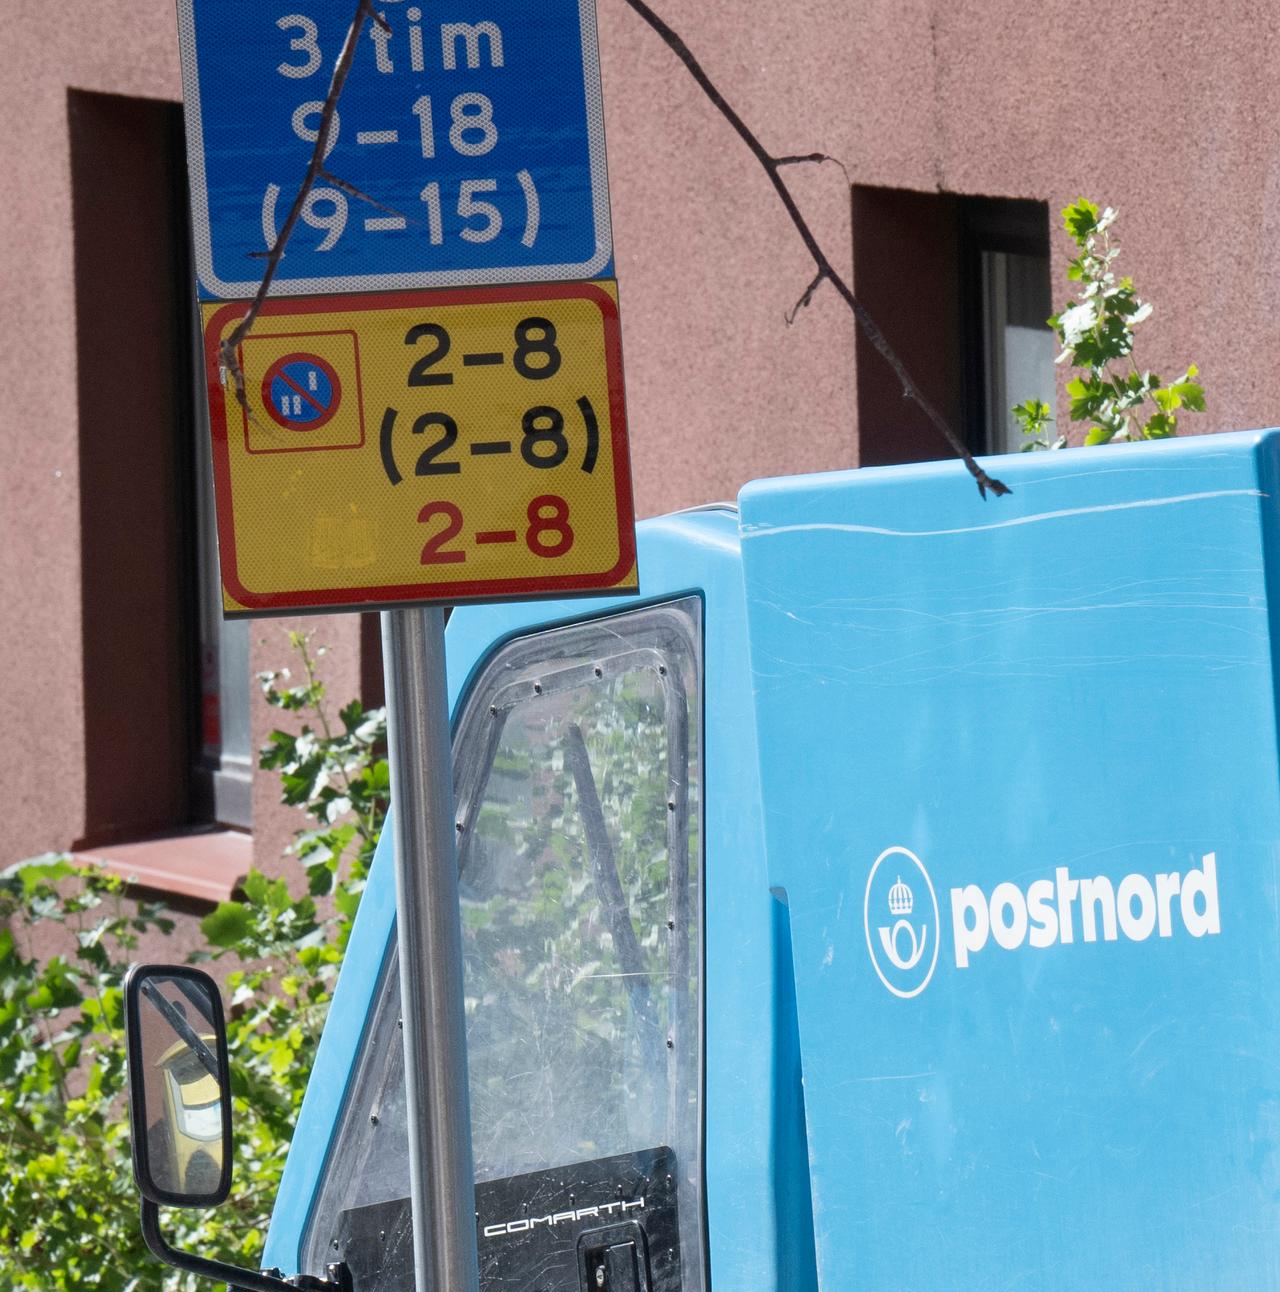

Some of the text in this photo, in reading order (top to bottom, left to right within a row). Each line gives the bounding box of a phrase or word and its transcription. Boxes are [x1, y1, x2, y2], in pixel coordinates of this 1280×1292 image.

[275, 7, 505, 80] 3 tim
[291, 91, 499, 165] 9-18
[261, 168, 540, 260] (9-15)
[404, 316, 562, 388] 2-8
[380, 396, 599, 486] (2-8)
[417, 494, 574, 566] 2-8
[951, 852, 1221, 968] postnord
[484, 1197, 644, 1238] COMARTH
